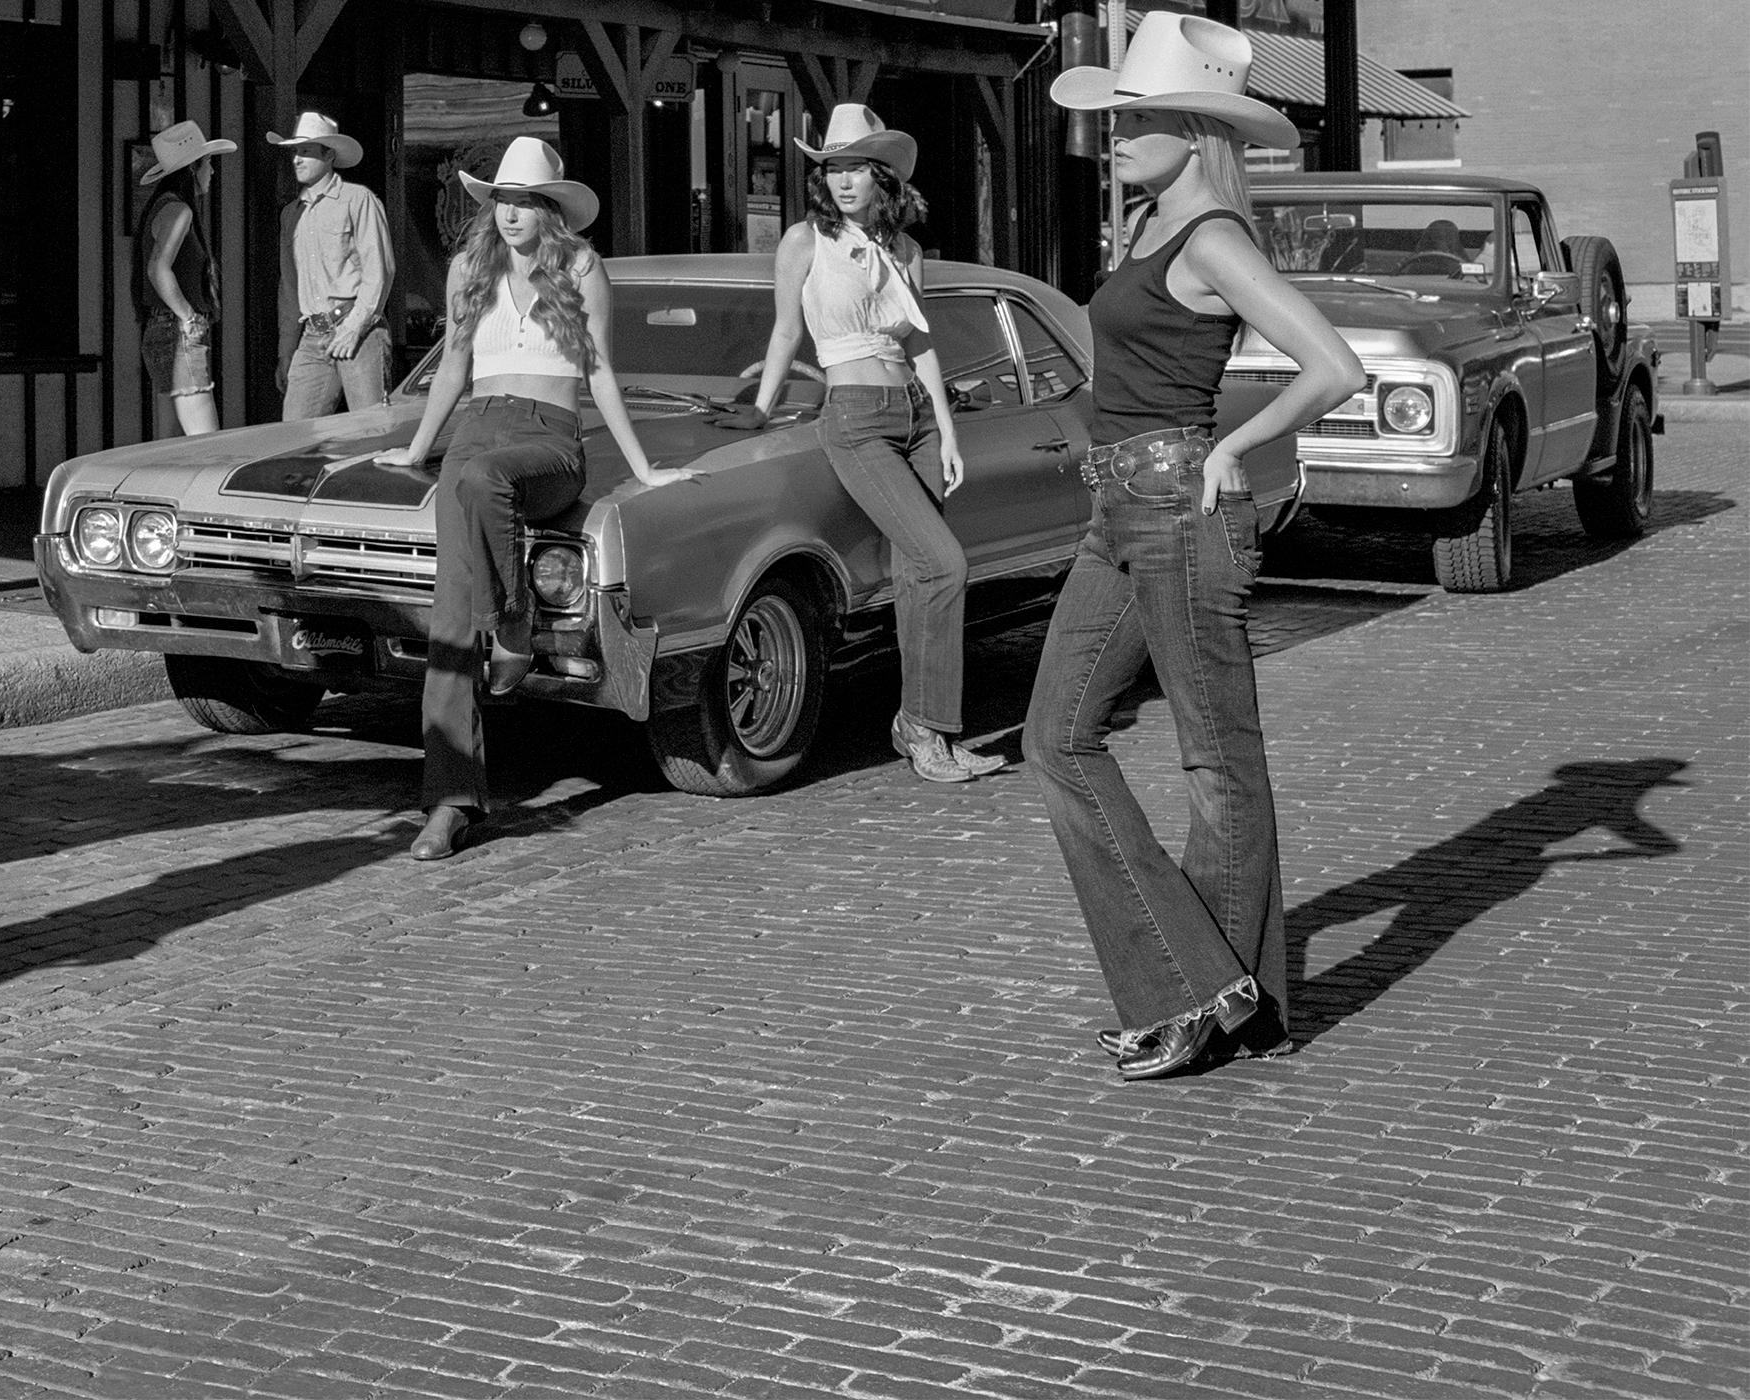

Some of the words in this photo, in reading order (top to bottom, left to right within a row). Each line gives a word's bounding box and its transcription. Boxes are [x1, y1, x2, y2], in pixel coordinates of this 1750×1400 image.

[561, 77, 594, 90] SILV
[654, 81, 687, 93] ONE
[291, 629, 365, 655] Oldsmobile
